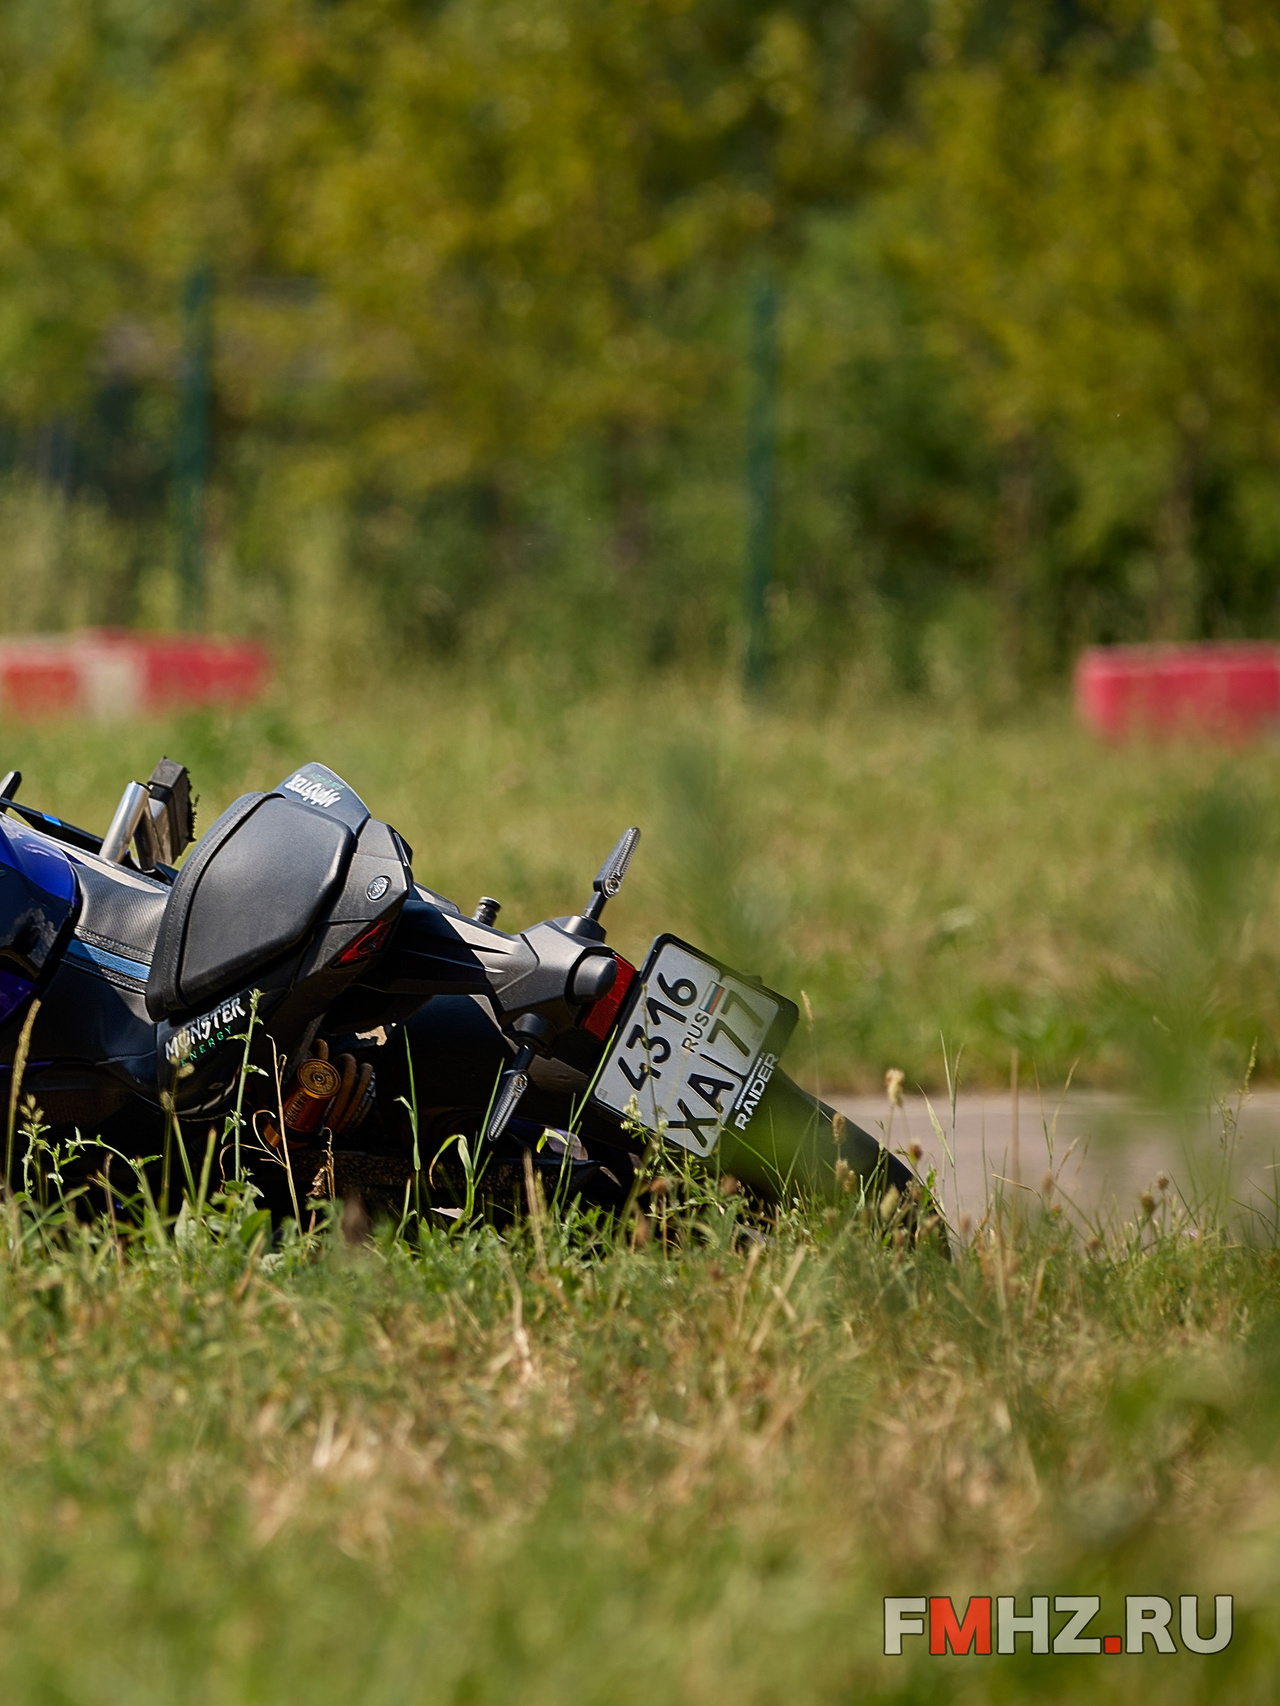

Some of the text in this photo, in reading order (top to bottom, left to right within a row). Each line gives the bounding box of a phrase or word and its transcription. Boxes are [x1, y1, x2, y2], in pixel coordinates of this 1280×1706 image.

[164, 996, 247, 1061] MONSTER
[180, 1024, 232, 1067] ENERGY
[617, 971, 698, 1092] 4316
[681, 1012, 710, 1053] RUS
[707, 990, 765, 1056] 77
[734, 1052, 779, 1131] RAIDER
